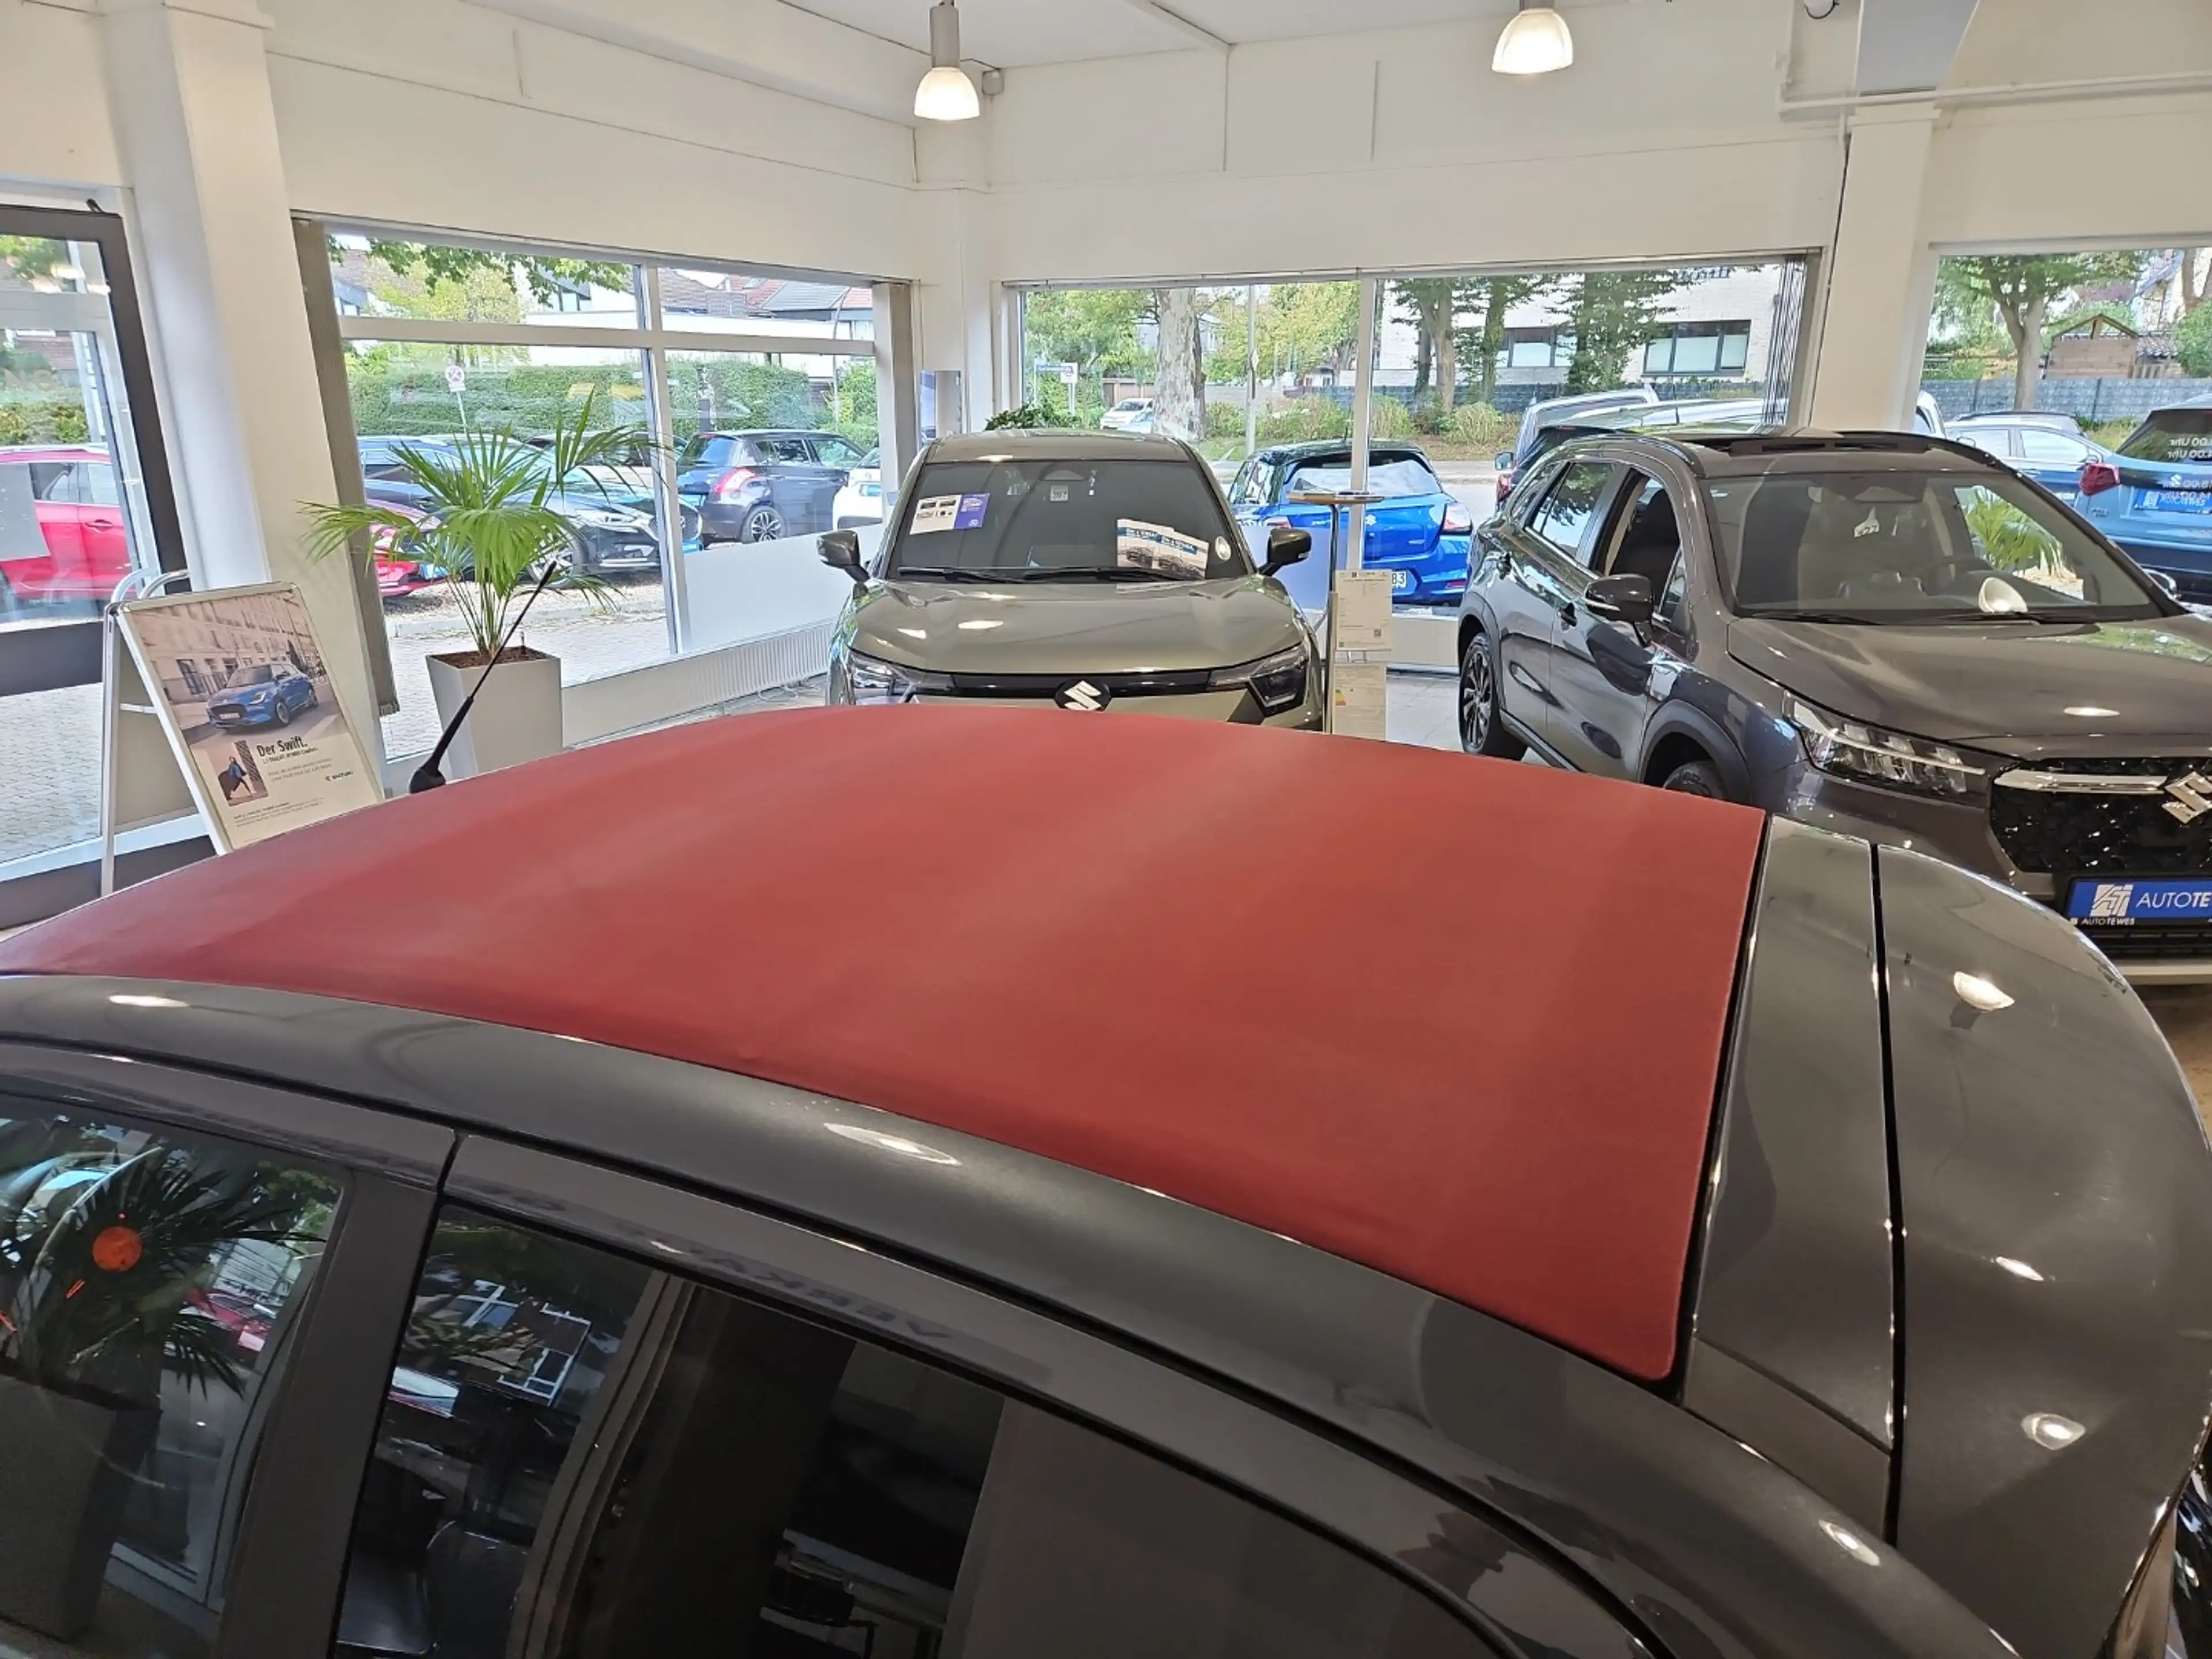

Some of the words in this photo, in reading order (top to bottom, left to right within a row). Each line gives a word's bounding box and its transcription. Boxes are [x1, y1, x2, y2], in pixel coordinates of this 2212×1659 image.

[256, 744, 275, 756] Der
[277, 736, 308, 752] Swift.
[2135, 891, 2212, 909] AUTOTE
[2080, 917, 2135, 926] AUTOTEWES
